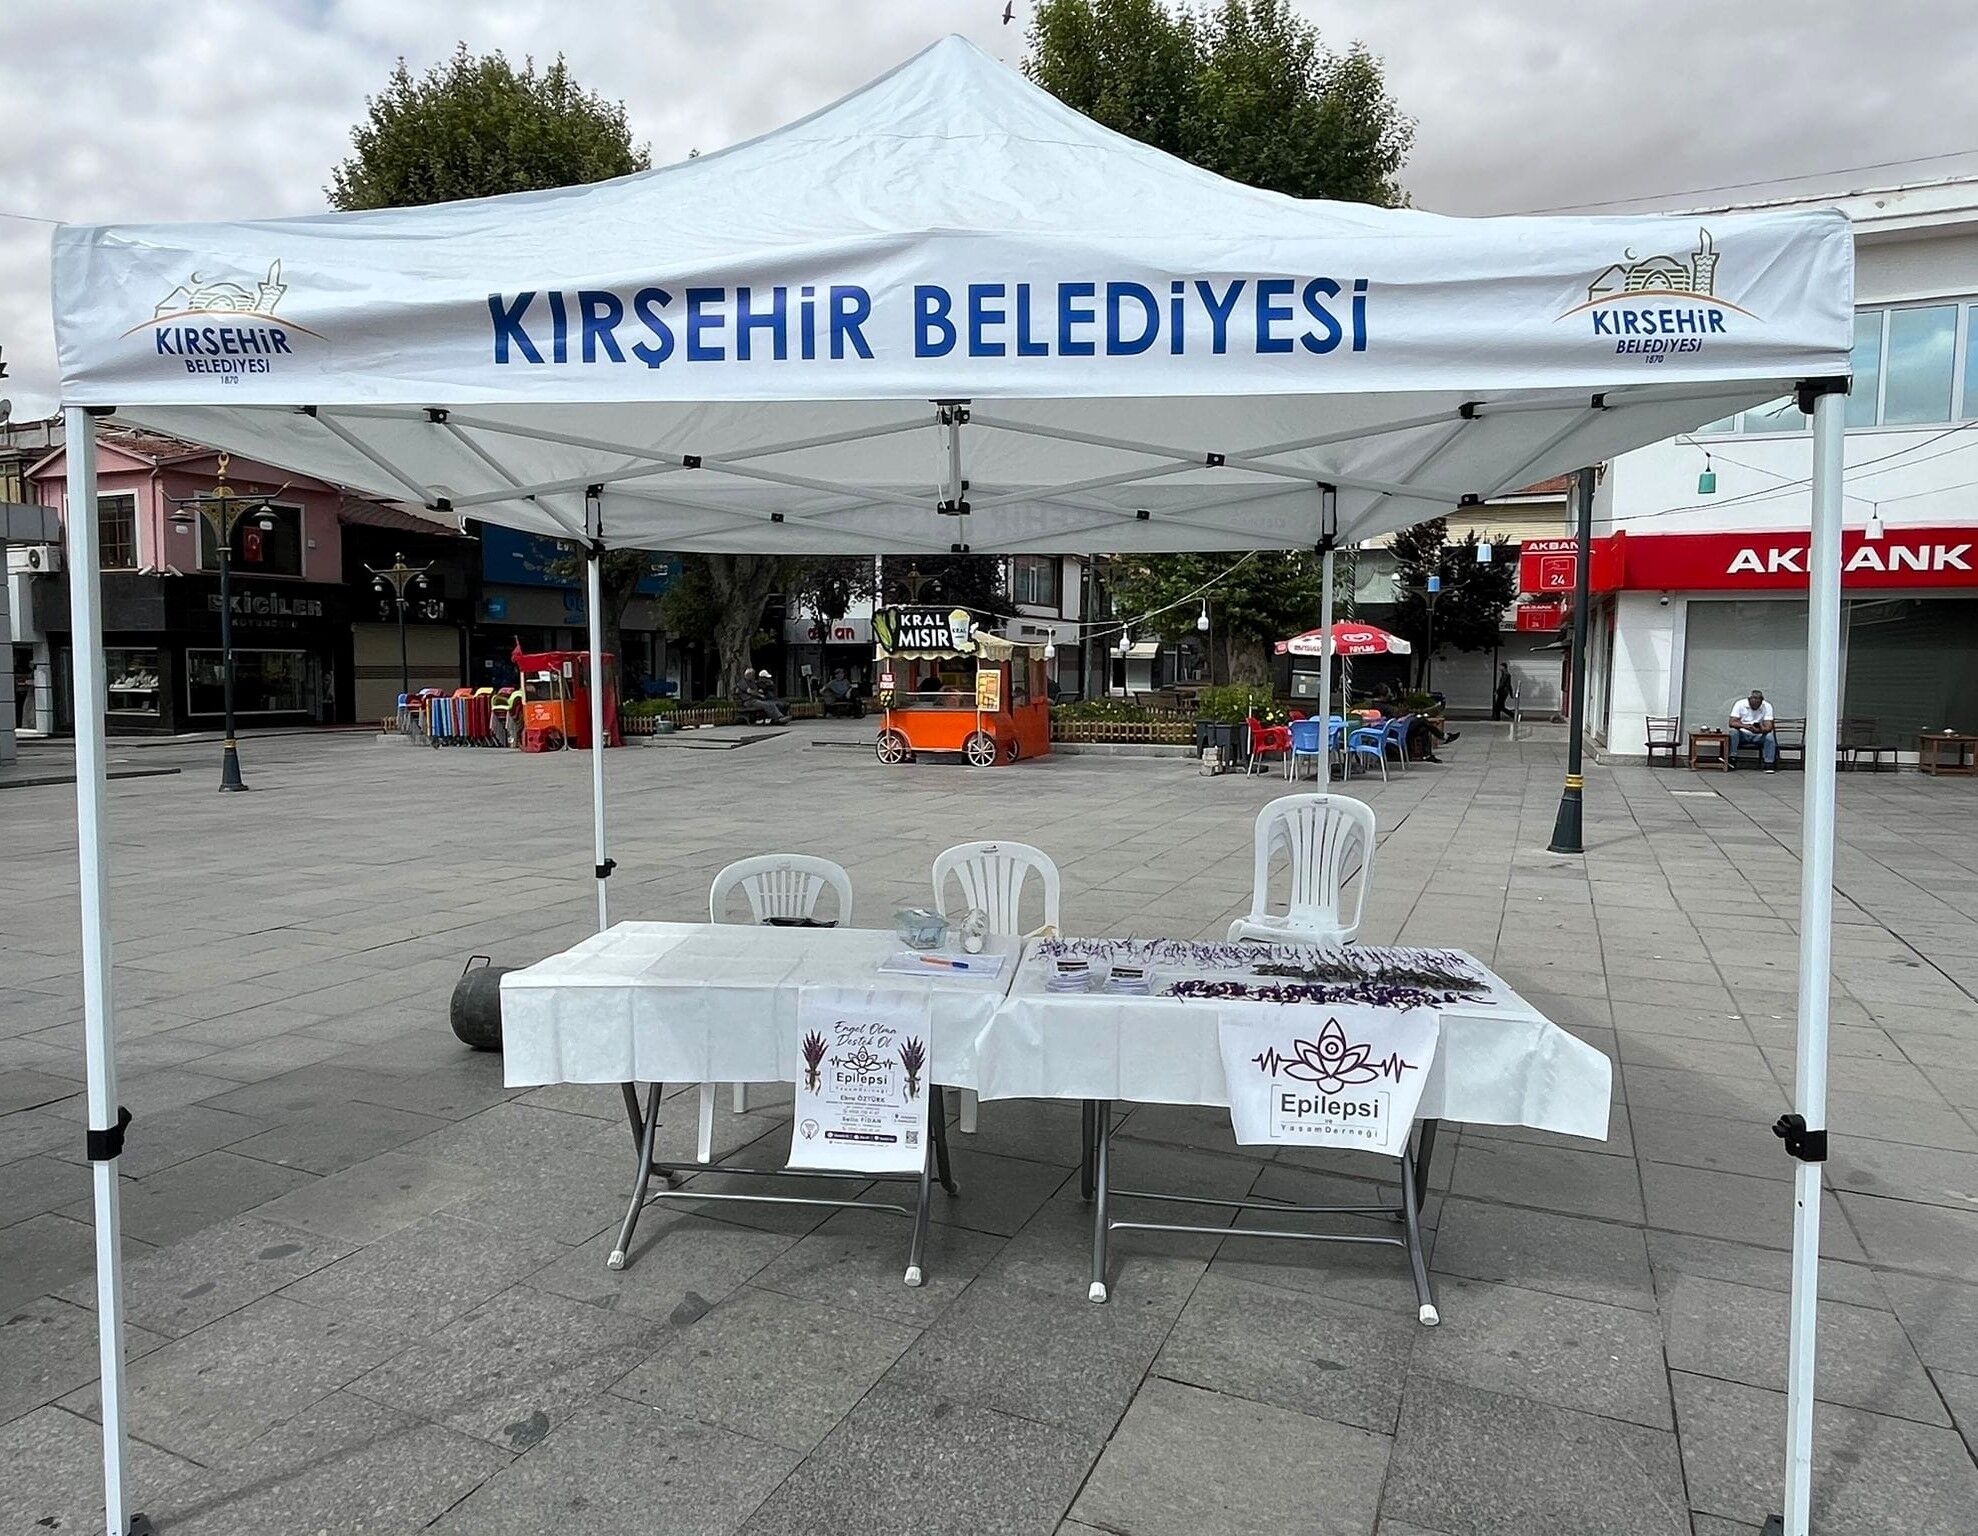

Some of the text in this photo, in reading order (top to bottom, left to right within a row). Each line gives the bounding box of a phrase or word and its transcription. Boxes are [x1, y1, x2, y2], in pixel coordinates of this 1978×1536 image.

[1645, 355, 1664, 364] 1870
[220, 375, 239, 385] 1870
[1529, 541, 1579, 551] AKBAN
[1726, 544, 1973, 573] AKANK
[1550, 574, 1565, 586] 24
[901, 614, 944, 626] KRAL
[898, 629, 950, 648] MISIR
[836, 1071, 888, 1086] Epilepsi
[1281, 1093, 1379, 1121] Epilepsi
